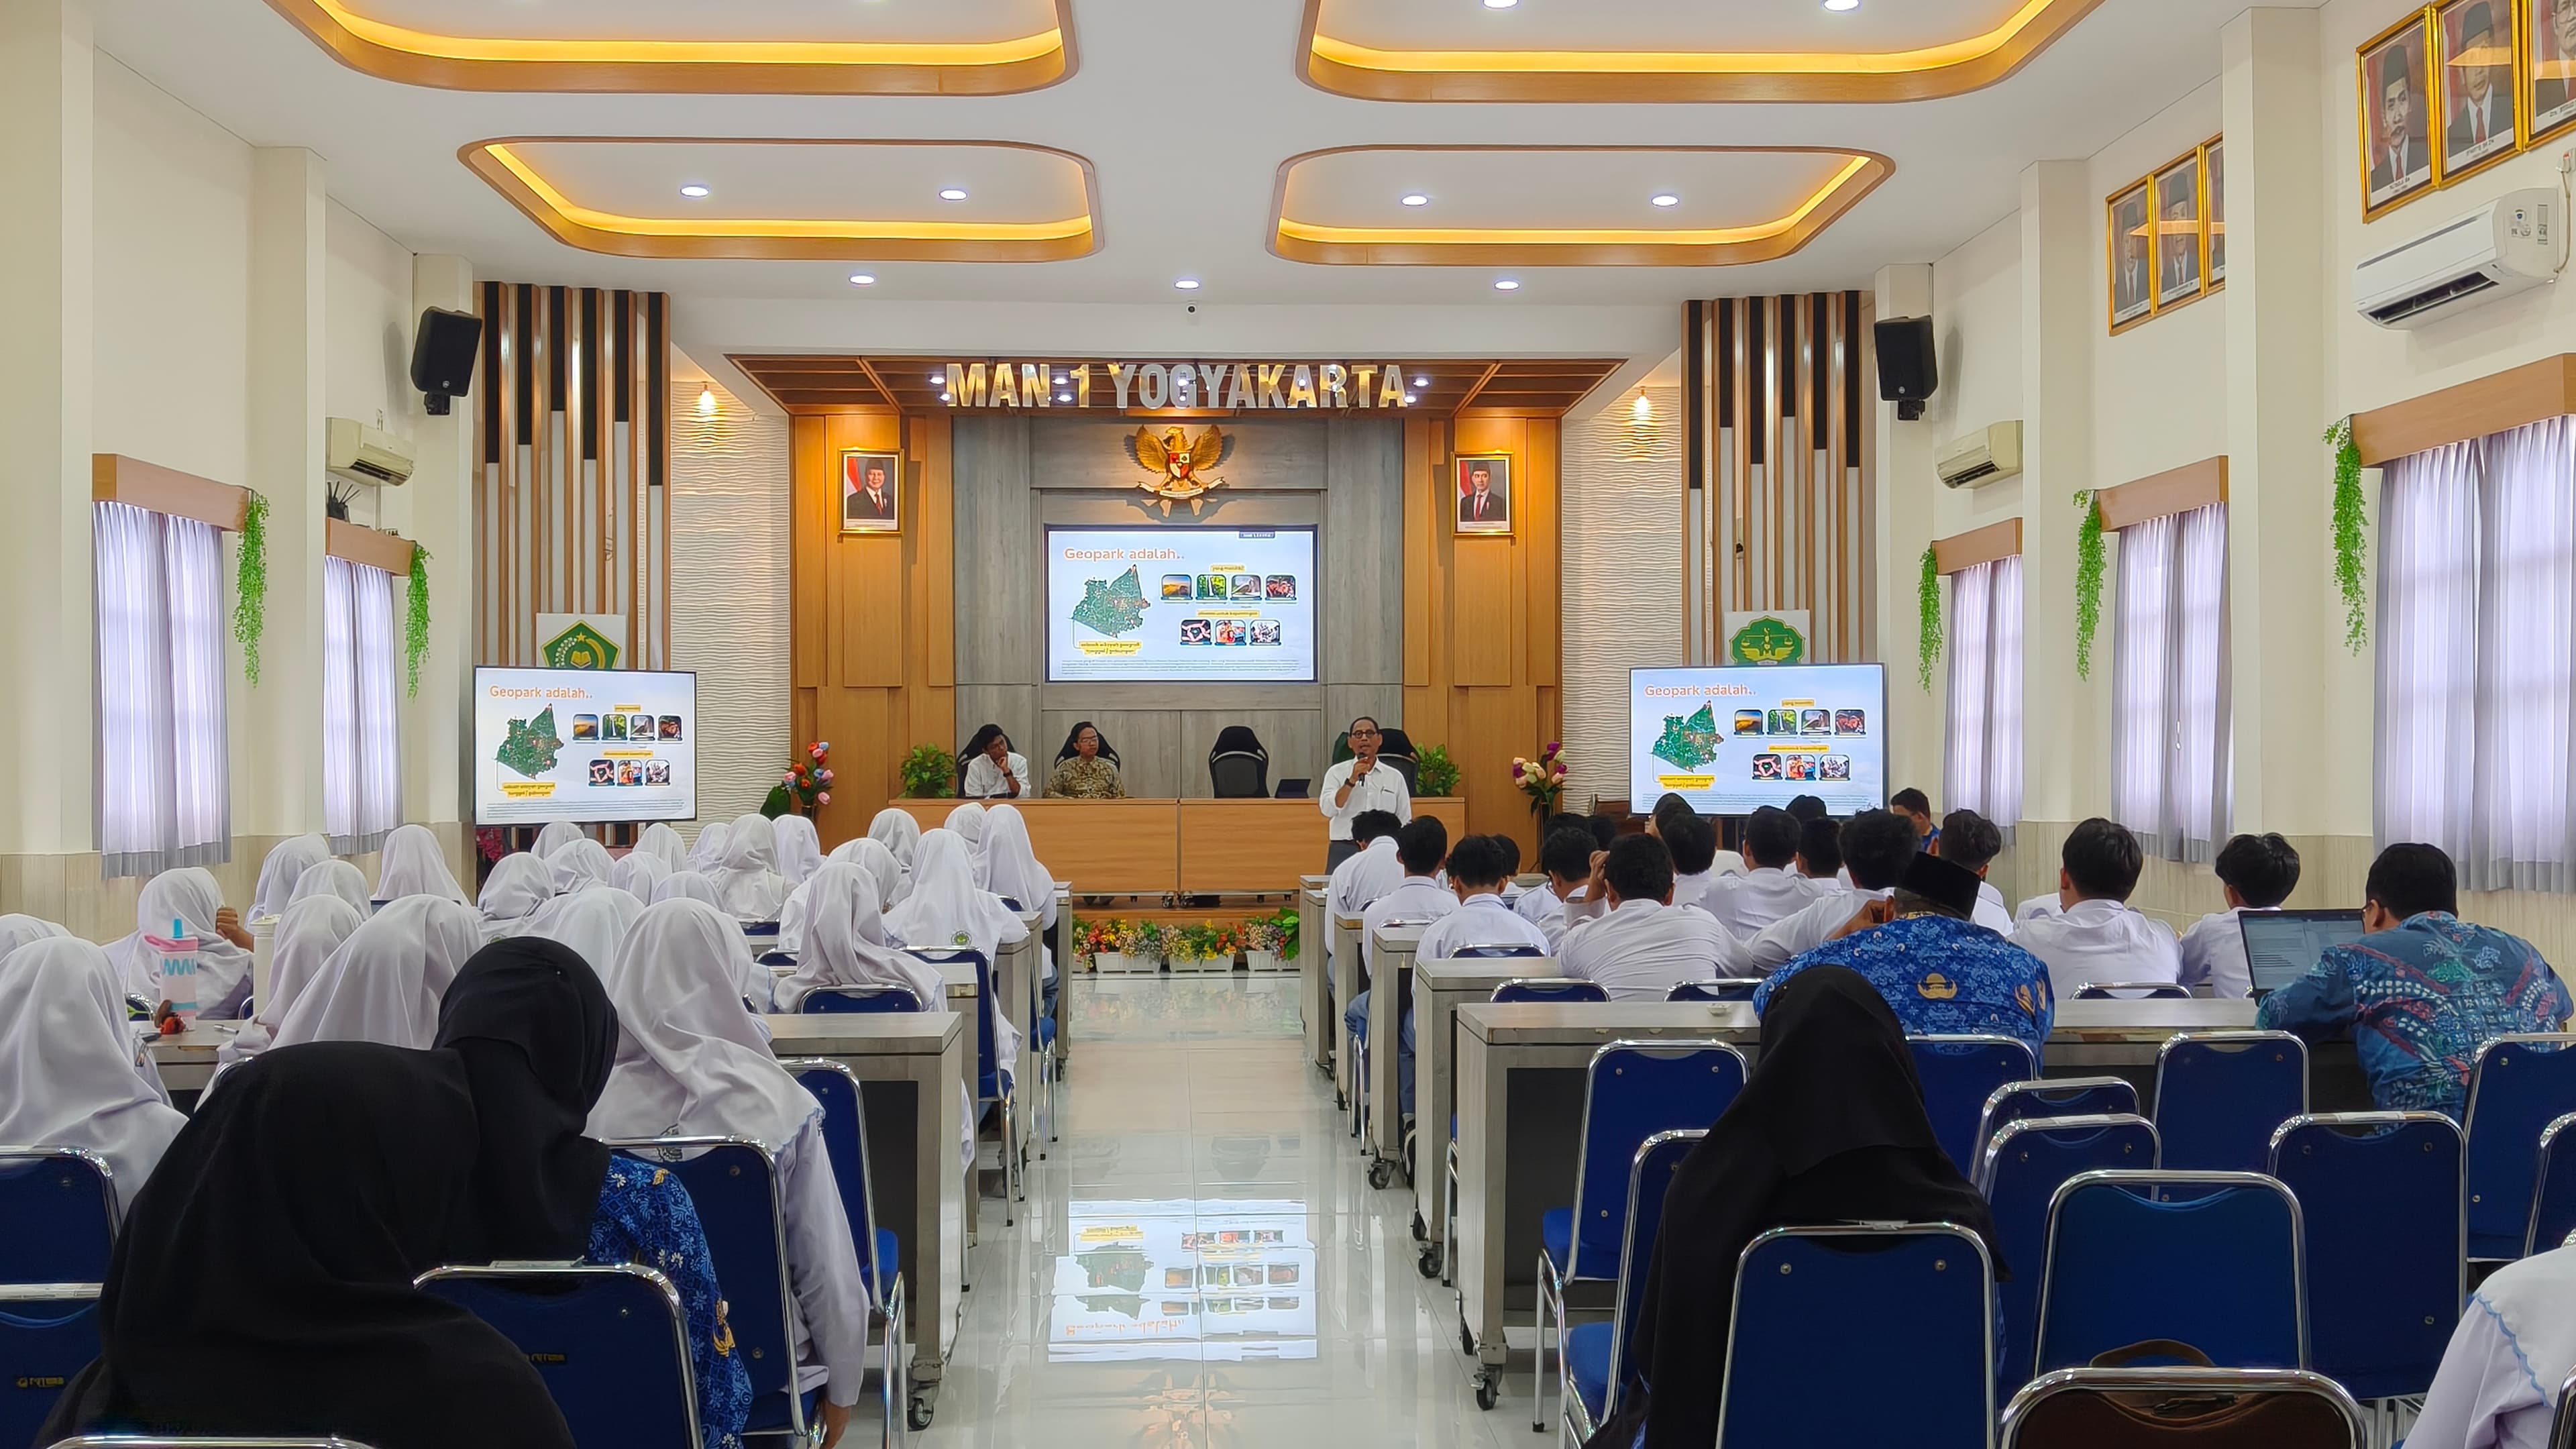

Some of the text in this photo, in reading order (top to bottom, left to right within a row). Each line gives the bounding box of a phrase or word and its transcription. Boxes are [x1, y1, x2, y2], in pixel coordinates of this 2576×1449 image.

[946, 363, 1408, 409] MAN 1 YOGYAKARTA
[1065, 548, 1185, 561] Geopark adalah..
[490, 685, 593, 700] Geopark adalah..
[1645, 685, 1700, 698] Geopark
